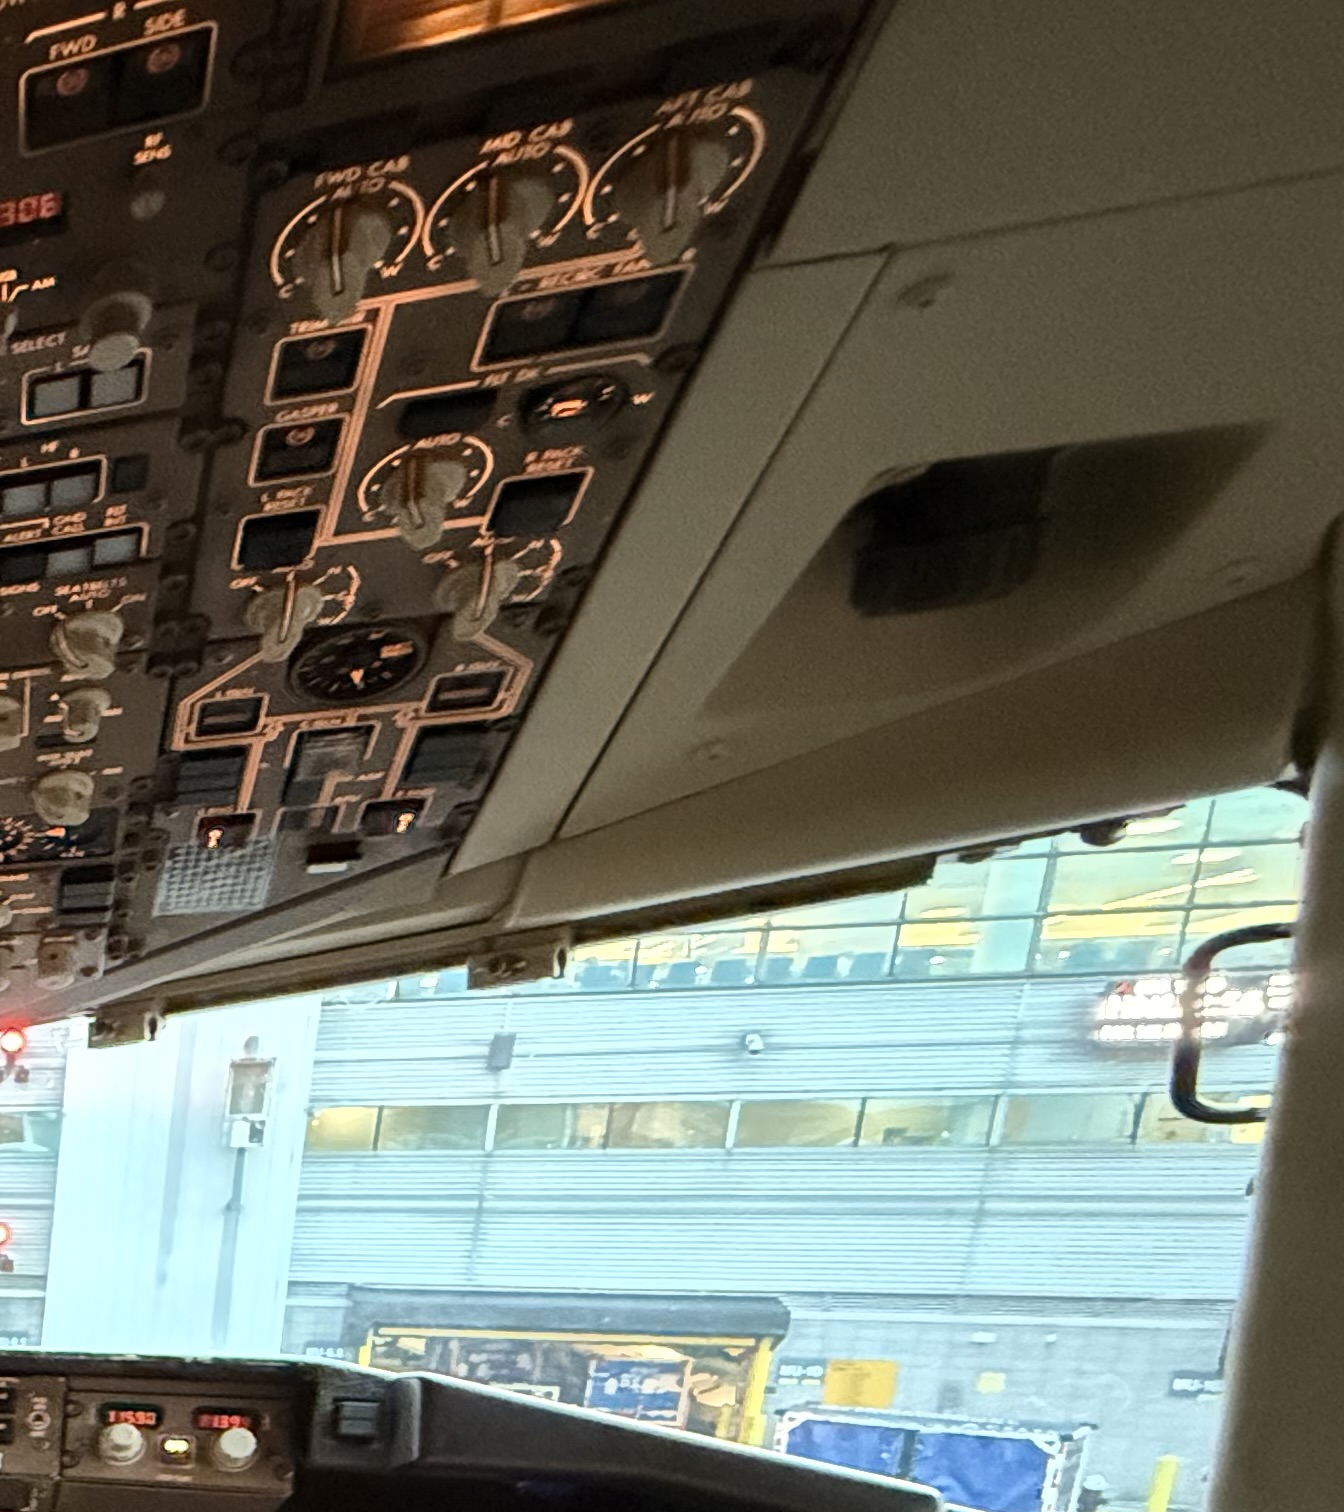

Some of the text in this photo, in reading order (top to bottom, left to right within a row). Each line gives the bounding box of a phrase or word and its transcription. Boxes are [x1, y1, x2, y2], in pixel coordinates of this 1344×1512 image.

[143, 9, 186, 36] SIDE
[49, 33, 97, 61] FWD
[11, 331, 66, 355] SELECT
[414, 432, 462, 448] AUTO
[2, 528, 43, 544] ALERT
